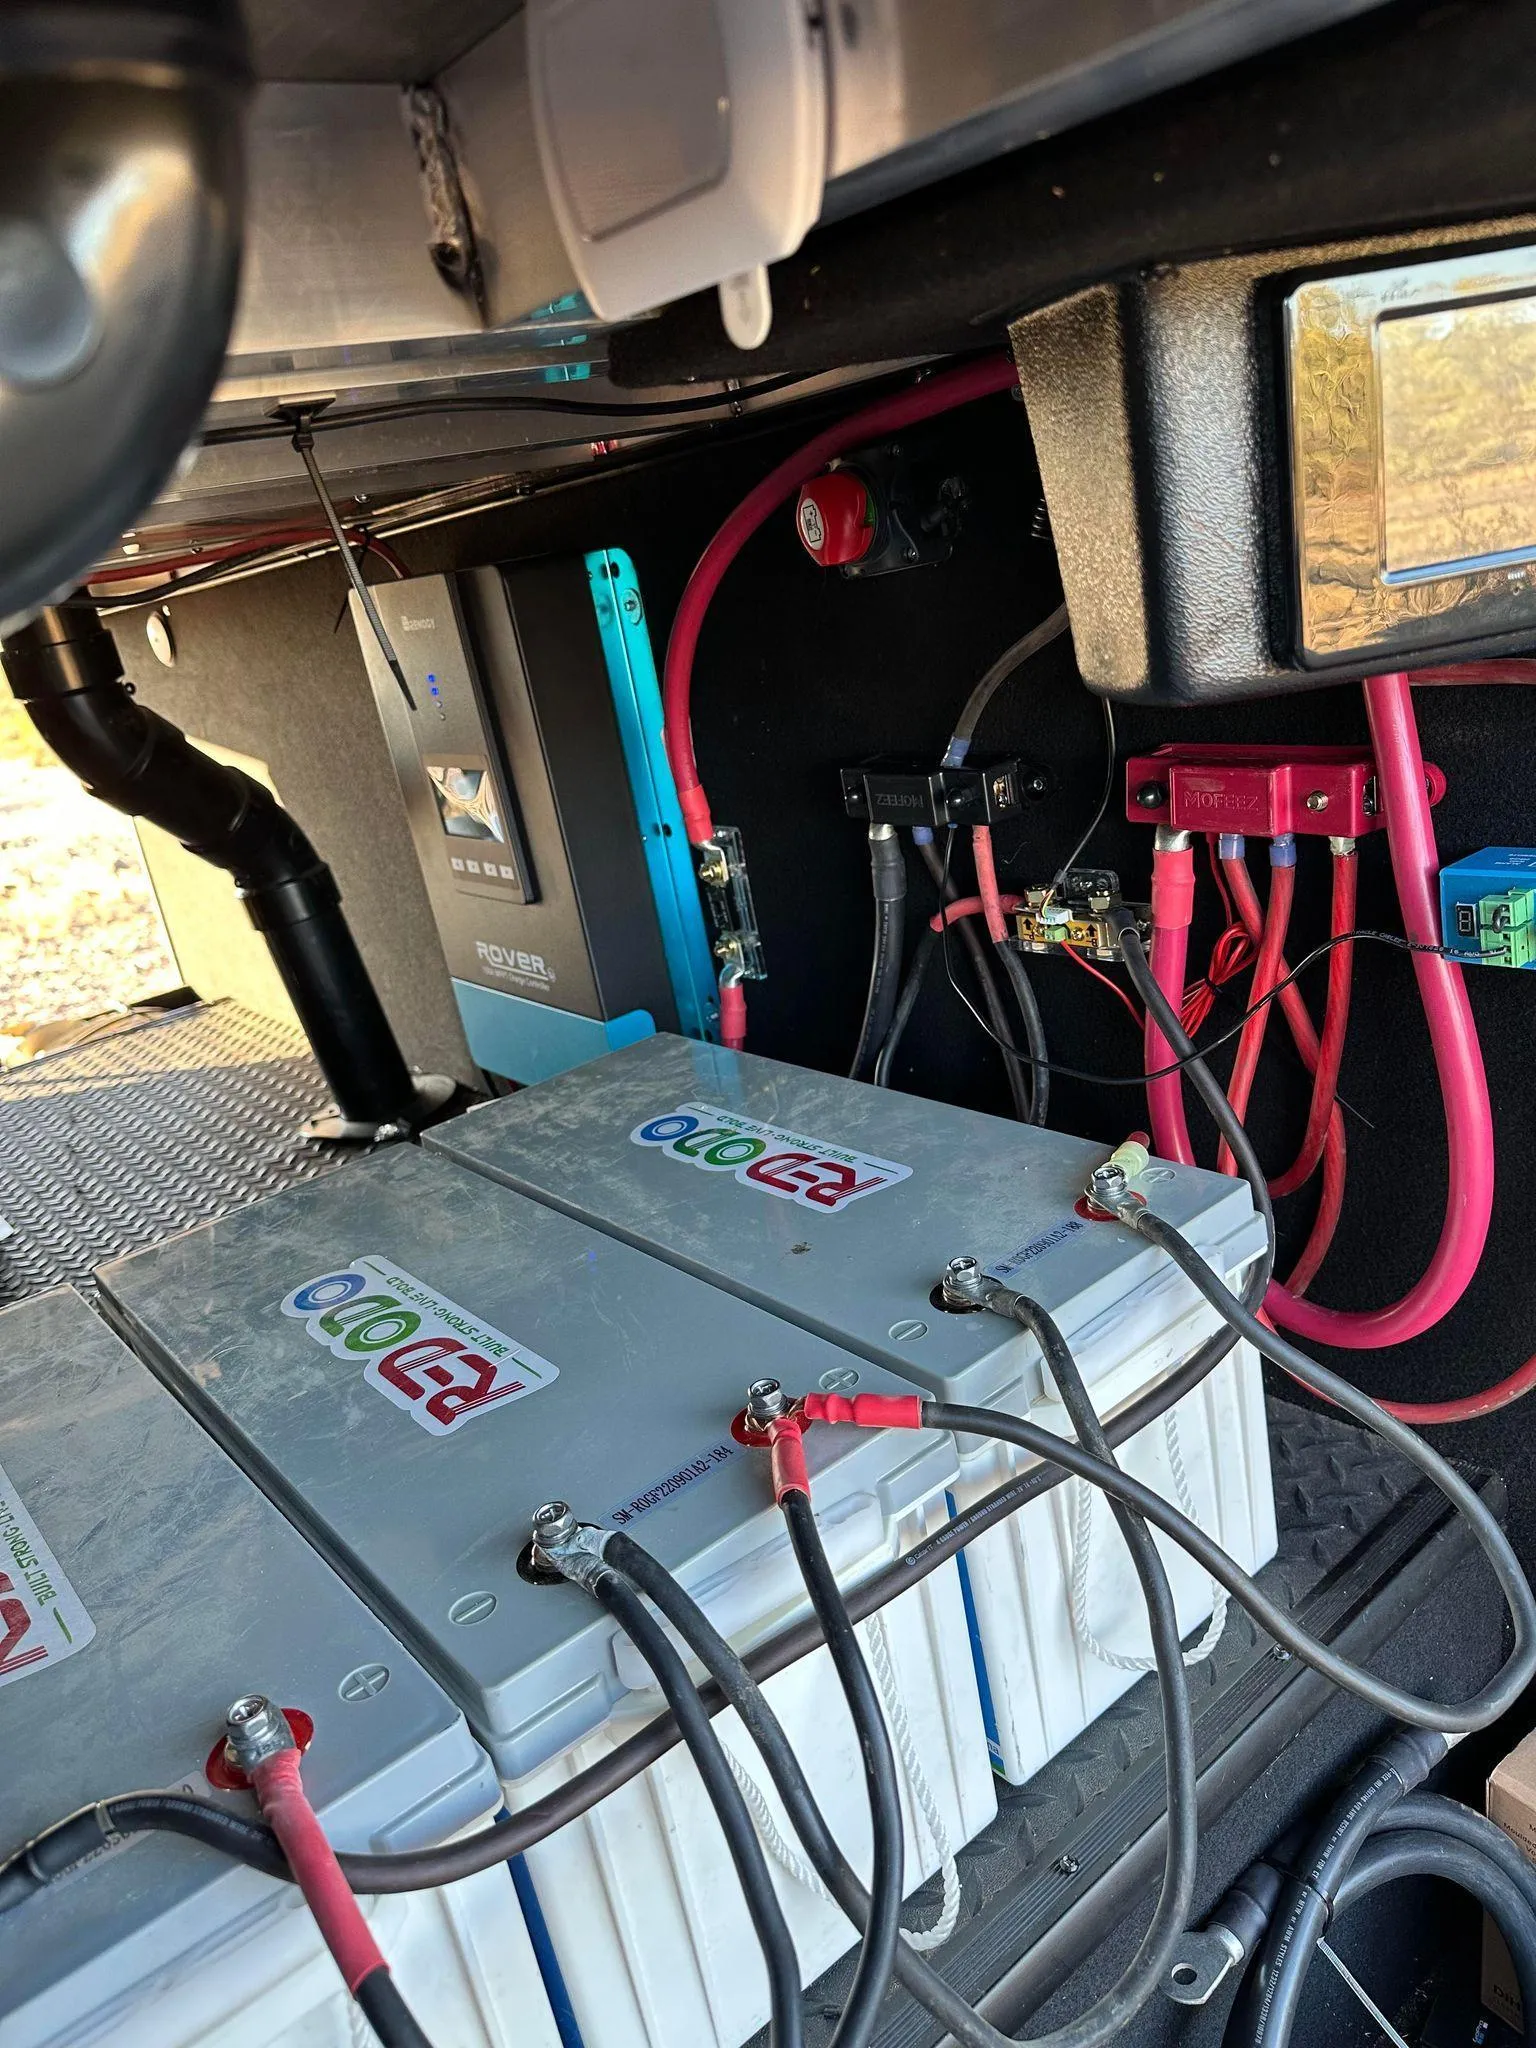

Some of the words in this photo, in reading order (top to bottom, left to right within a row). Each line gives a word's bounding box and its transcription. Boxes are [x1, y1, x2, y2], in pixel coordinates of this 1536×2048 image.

[1184, 791, 1259, 811] MOFEEZ
[476, 941, 549, 979] ROVER
[385, 1274, 414, 1295] BOLD
[472, 1331, 509, 1356] BUILT
[24, 1569, 57, 1607] BUILT
[1346, 1808, 1356, 1819] AWG
[1294, 1899, 1305, 1914] MTW
[1283, 1924, 1294, 1942] AWM
[1274, 1943, 1287, 1966] STYLES
